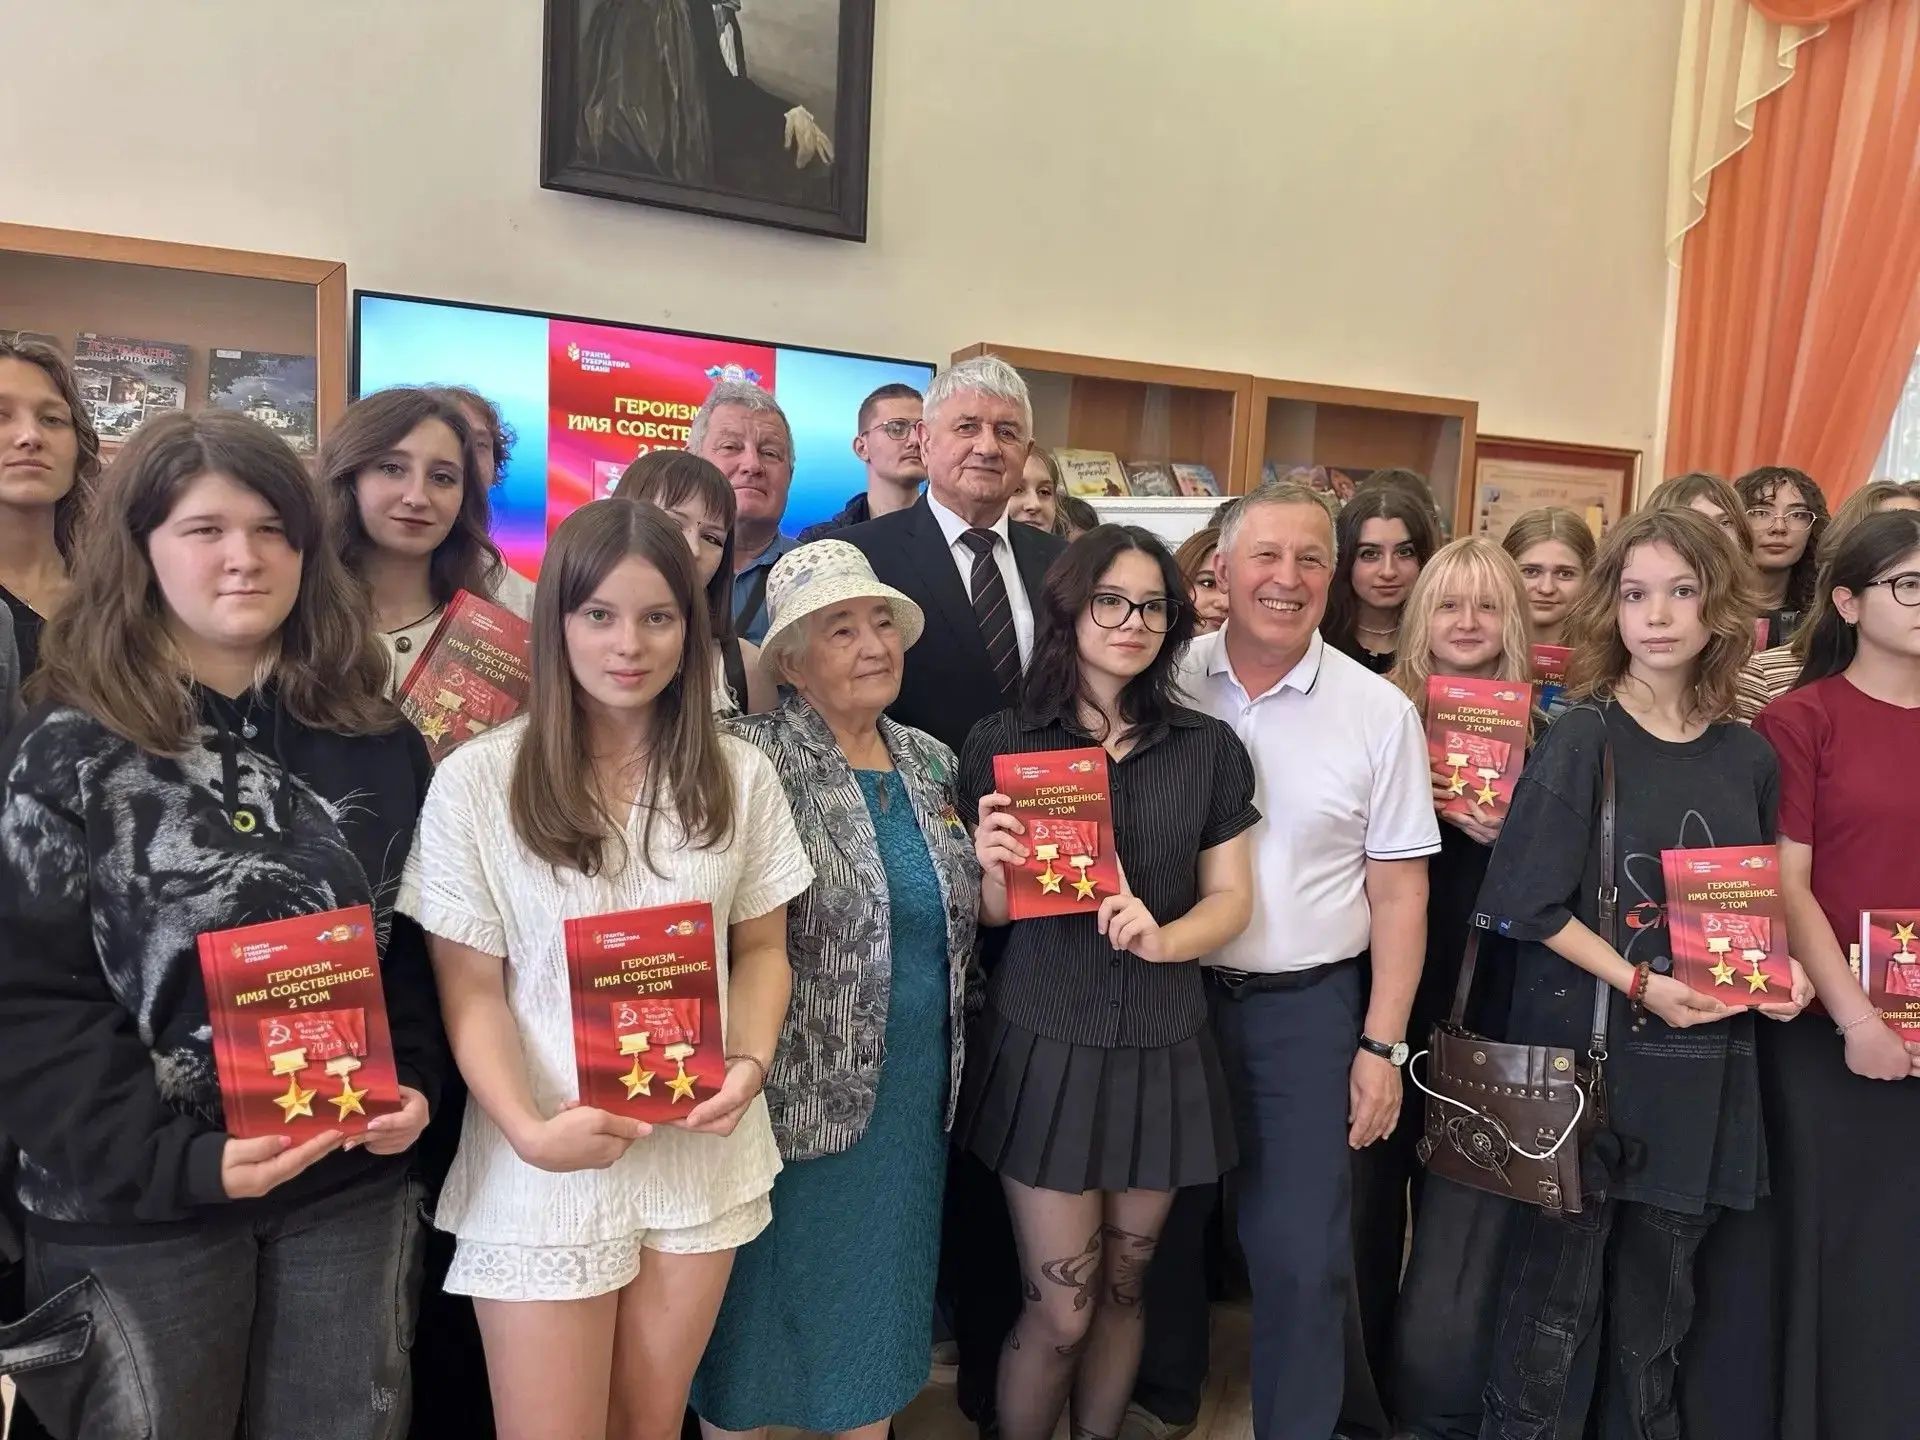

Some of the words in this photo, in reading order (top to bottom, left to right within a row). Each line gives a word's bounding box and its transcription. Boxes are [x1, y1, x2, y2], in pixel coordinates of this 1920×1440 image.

[568, 413, 611, 435] ИМЯ
[616, 419, 693, 441] СОБСТВ
[475, 638, 521, 665] ГЕРОИЗМ
[447, 637, 470, 654] ИМЯ
[471, 649, 530, 683] СОБСТВЕНН
[475, 663, 482, 671] 2
[484, 666, 506, 683] ТОМ
[1437, 712, 1456, 721] ИМЯ
[1458, 706, 1499, 717] ГЕРОИЗМ
[1473, 725, 1492, 733] ТОМ
[1035, 785, 1078, 796] ГЕРОИЗМ
[1016, 799, 1037, 808] ИМЯ
[1048, 807, 1055, 816] 2
[1056, 805, 1076, 815] ТОМ
[1707, 881, 1750, 890] ГЕРОИЗМ
[1688, 891, 1708, 901] ИМЯ
[1720, 902, 1727, 910] 2
[1728, 901, 1748, 909] ТОМ
[621, 952, 676, 970] ГЕРОИЗМ
[267, 960, 332, 984] ГЕРОИЗМ
[594, 976, 621, 988] ИМЯ
[637, 984, 645, 995] 2
[646, 980, 673, 993] ТОМ
[236, 989, 268, 1006] ИМЯ
[288, 998, 298, 1009] 2
[300, 990, 331, 1006] ТОМ
[1905, 1002, 1920, 1010] ОМ
